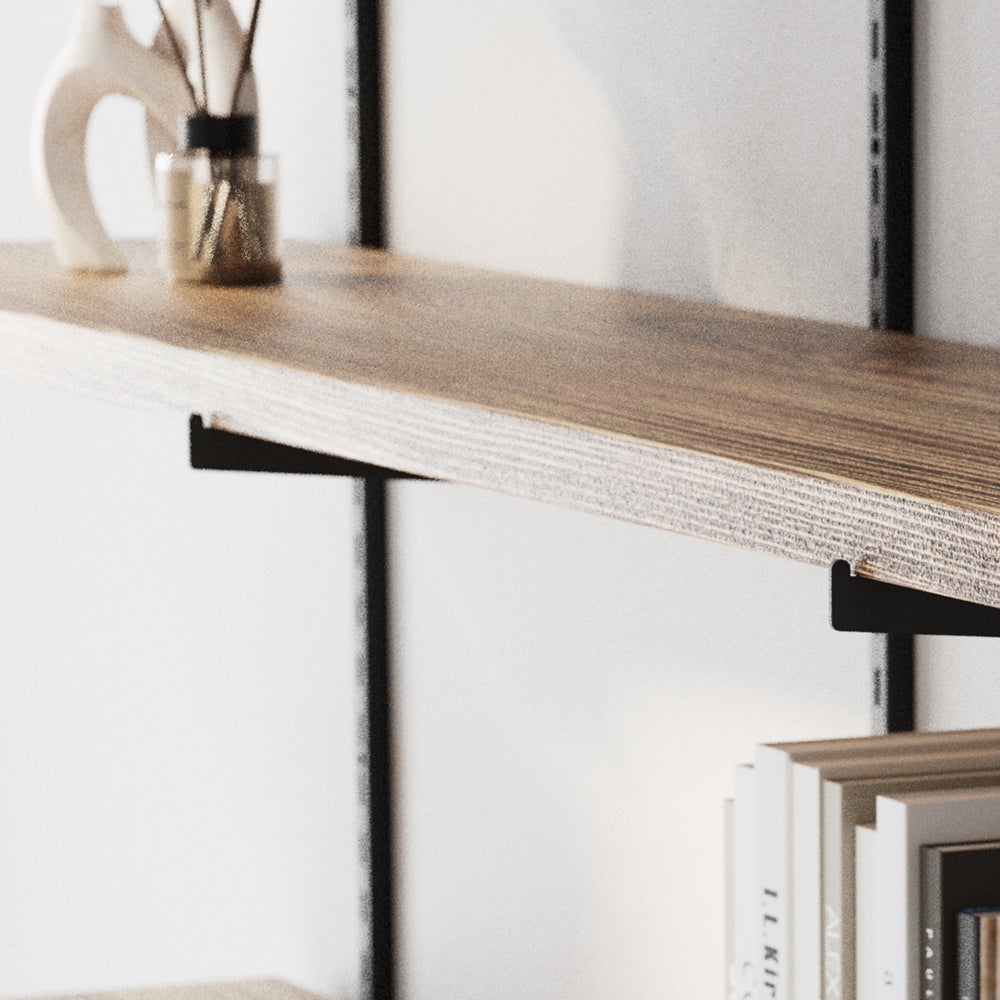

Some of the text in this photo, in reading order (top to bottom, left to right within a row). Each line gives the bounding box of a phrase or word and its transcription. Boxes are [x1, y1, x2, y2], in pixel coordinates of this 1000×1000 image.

[825, 904, 841, 994] ALEX
[884, 969, 894, 987] a
[924, 926, 936, 999] PAUL
